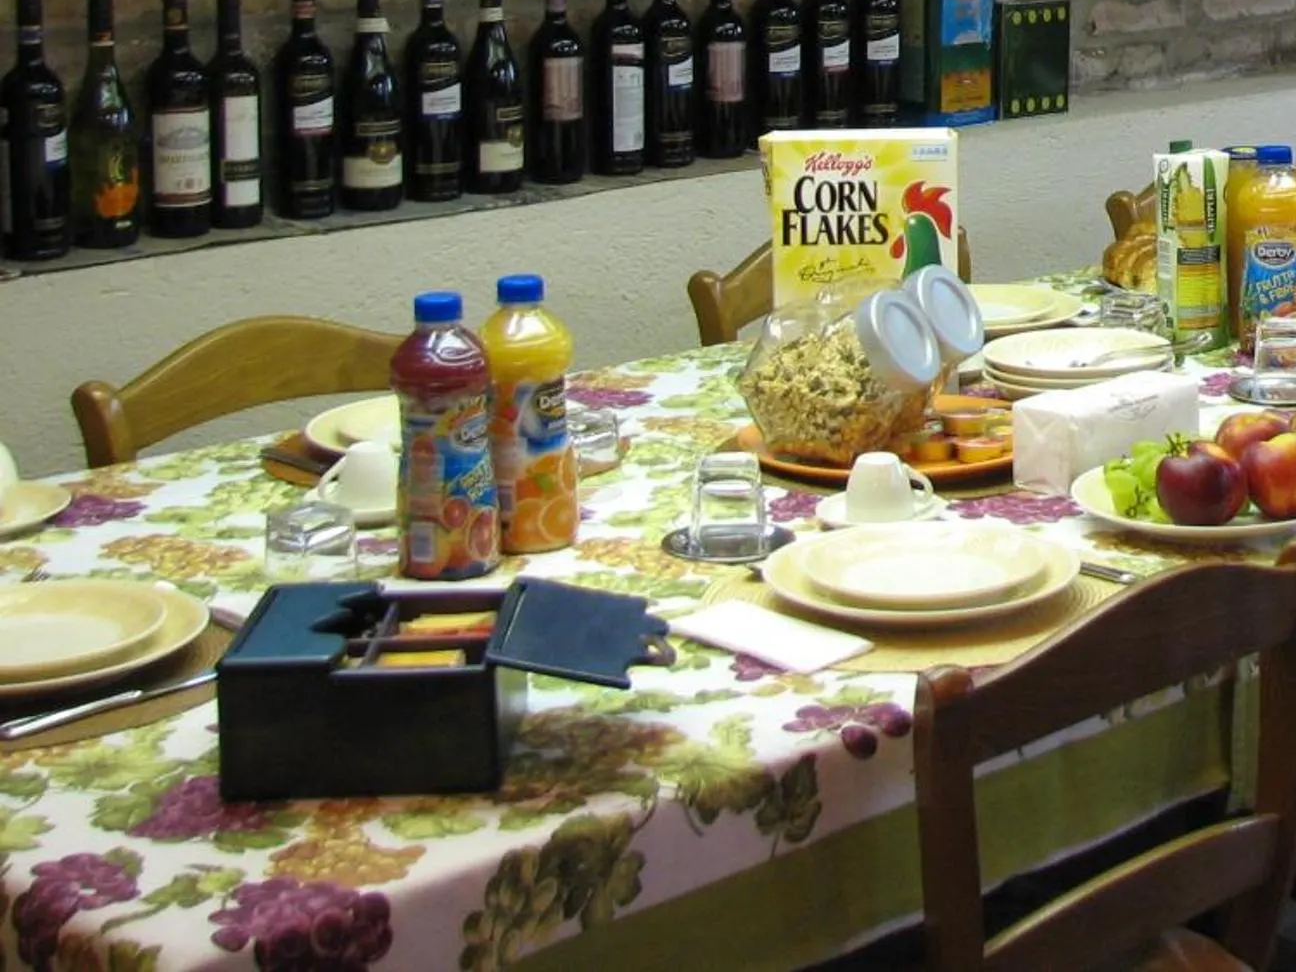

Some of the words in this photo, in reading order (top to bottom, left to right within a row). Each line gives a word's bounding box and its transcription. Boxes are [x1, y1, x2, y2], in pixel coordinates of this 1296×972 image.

[805, 151, 873, 176] Kellogg's
[793, 176, 878, 213] CORN
[781, 210, 889, 245] FLAKES
[1257, 247, 1292, 259] Derby
